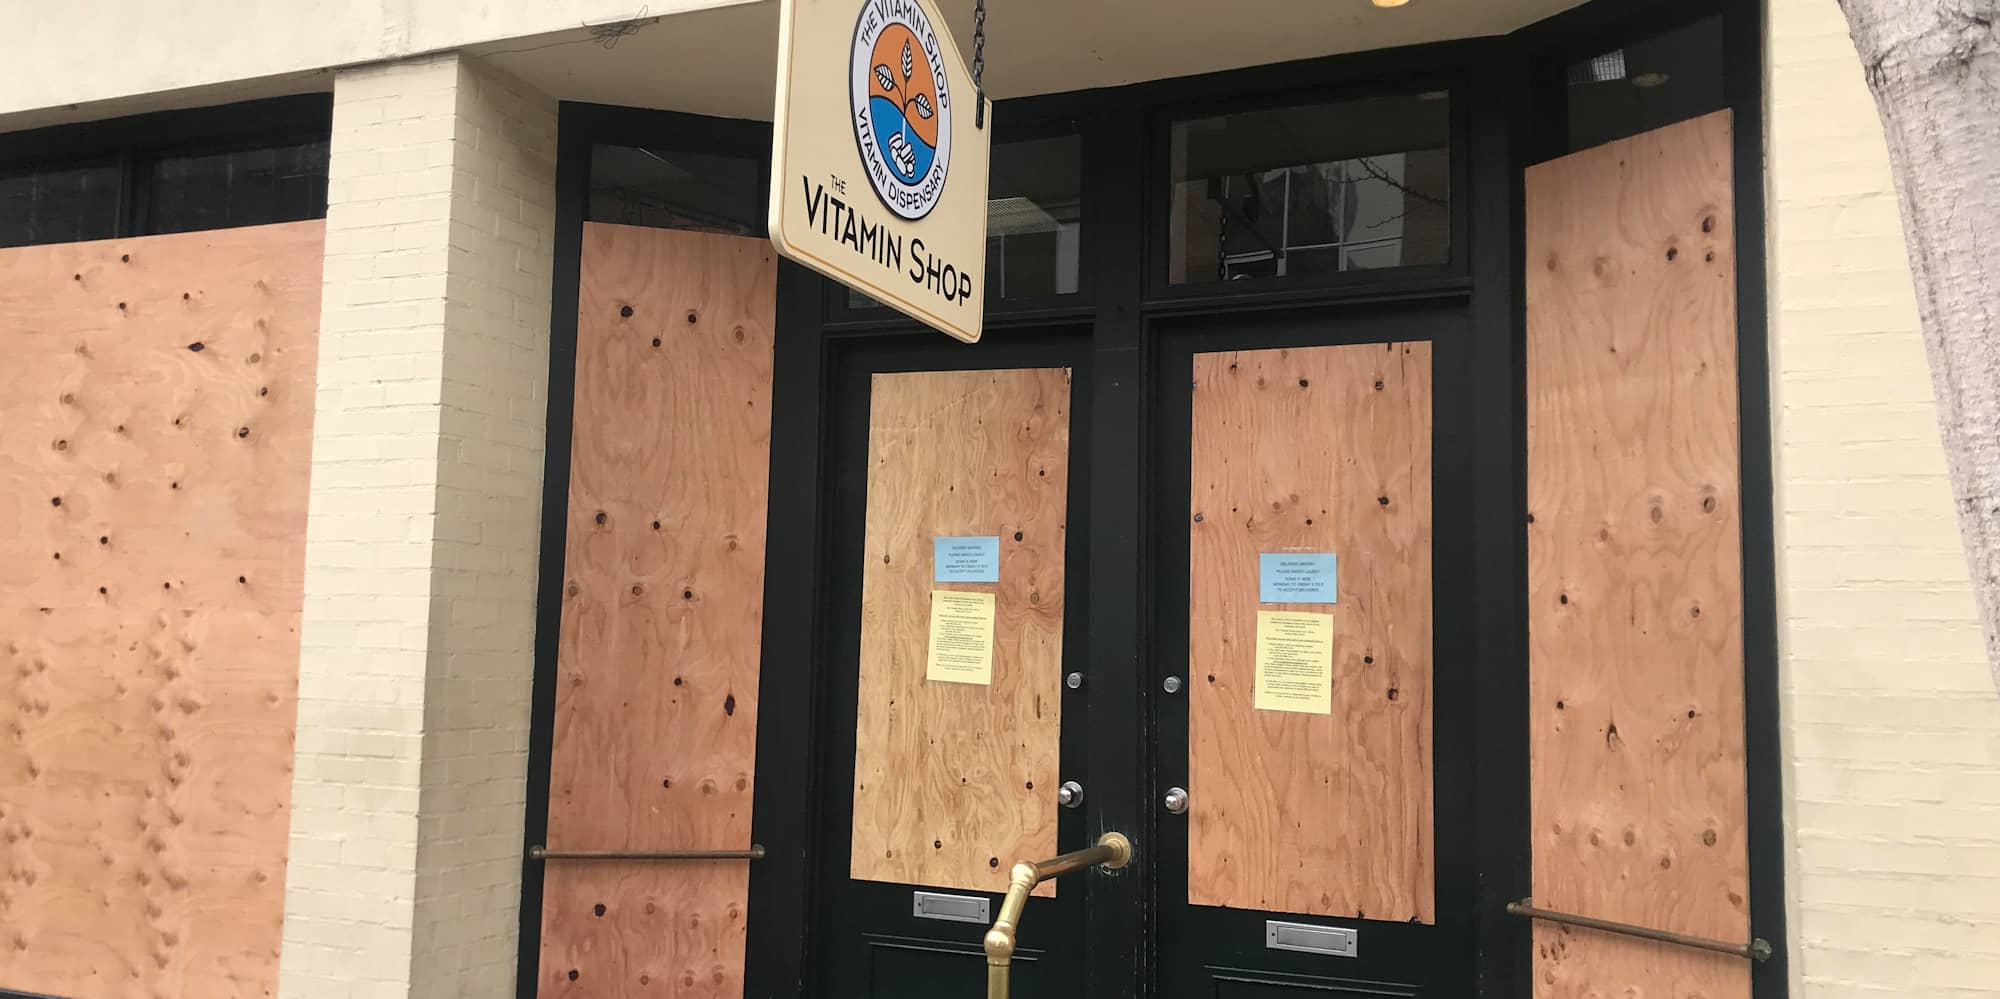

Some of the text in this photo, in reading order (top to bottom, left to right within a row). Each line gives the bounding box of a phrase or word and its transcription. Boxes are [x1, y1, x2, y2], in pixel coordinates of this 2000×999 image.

[861, 11, 877, 47] THE
[925, 33, 947, 108] SHOP
[831, 174, 847, 195] THE
[858, 107, 944, 210] VITAMIN DISPENSARY
[803, 175, 972, 307] VITAMIN SHOP
